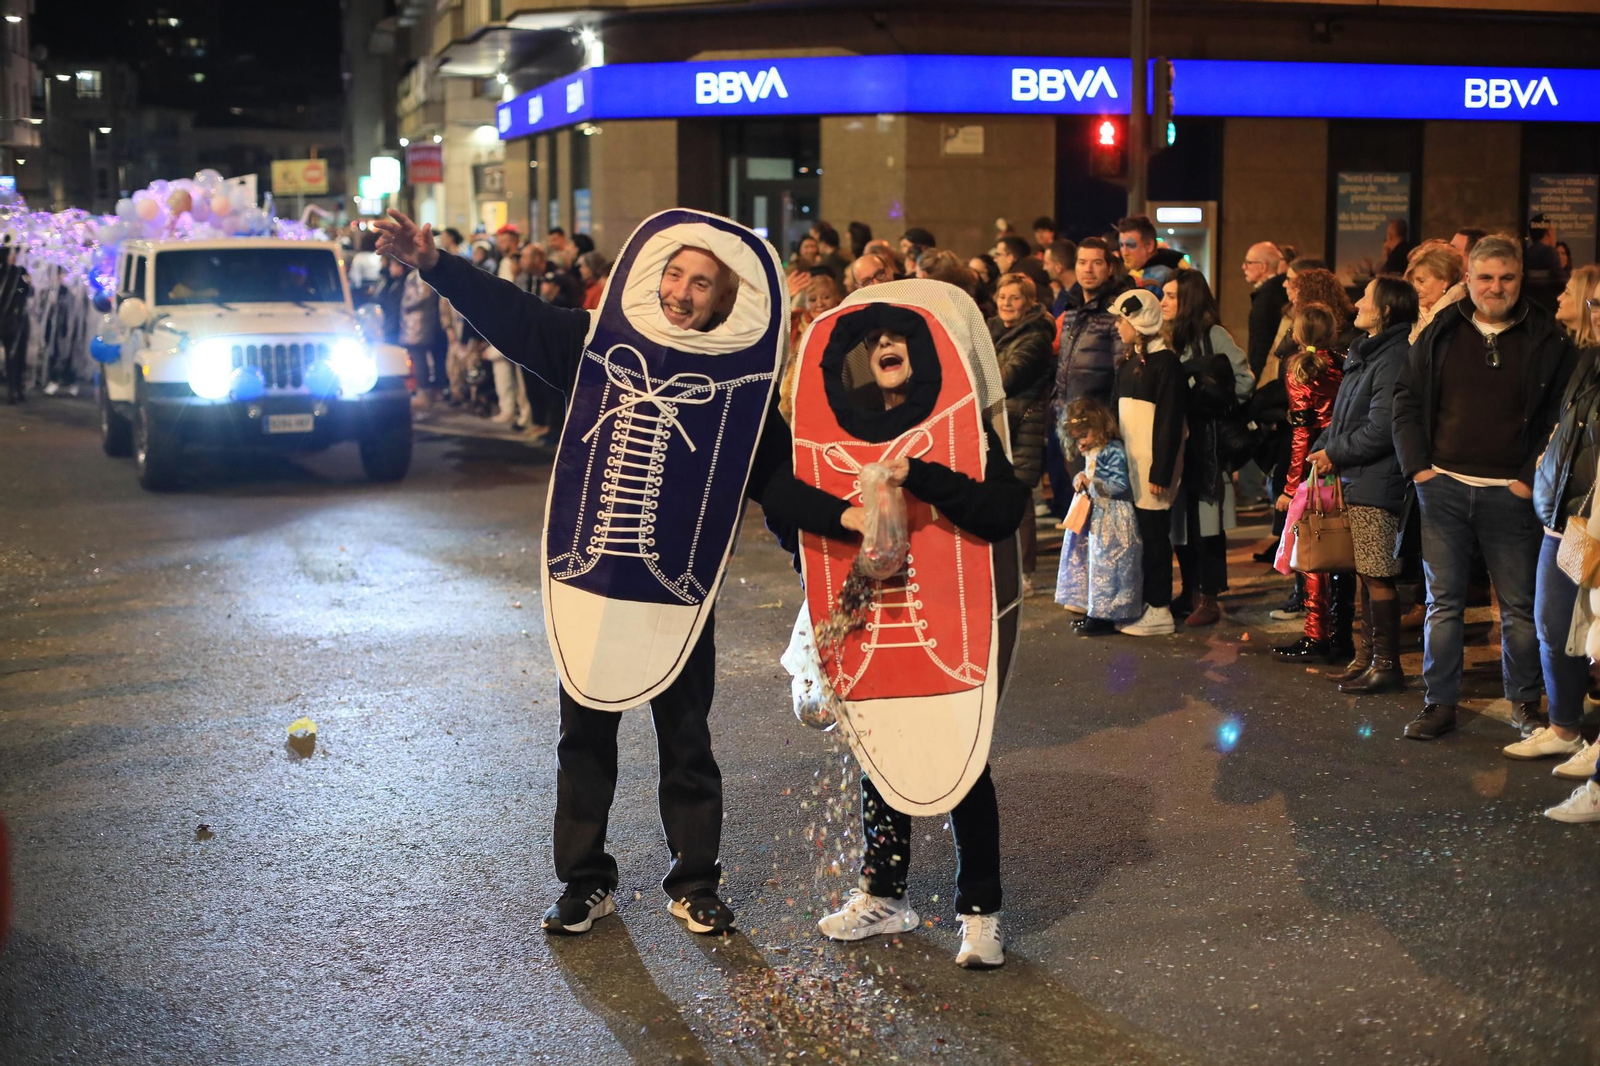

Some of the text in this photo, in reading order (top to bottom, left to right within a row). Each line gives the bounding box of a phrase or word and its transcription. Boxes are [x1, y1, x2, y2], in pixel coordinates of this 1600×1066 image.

[696, 66, 789, 104] BBVA
[1012, 66, 1118, 101] BBVA
[1465, 76, 1558, 109] BBVA
